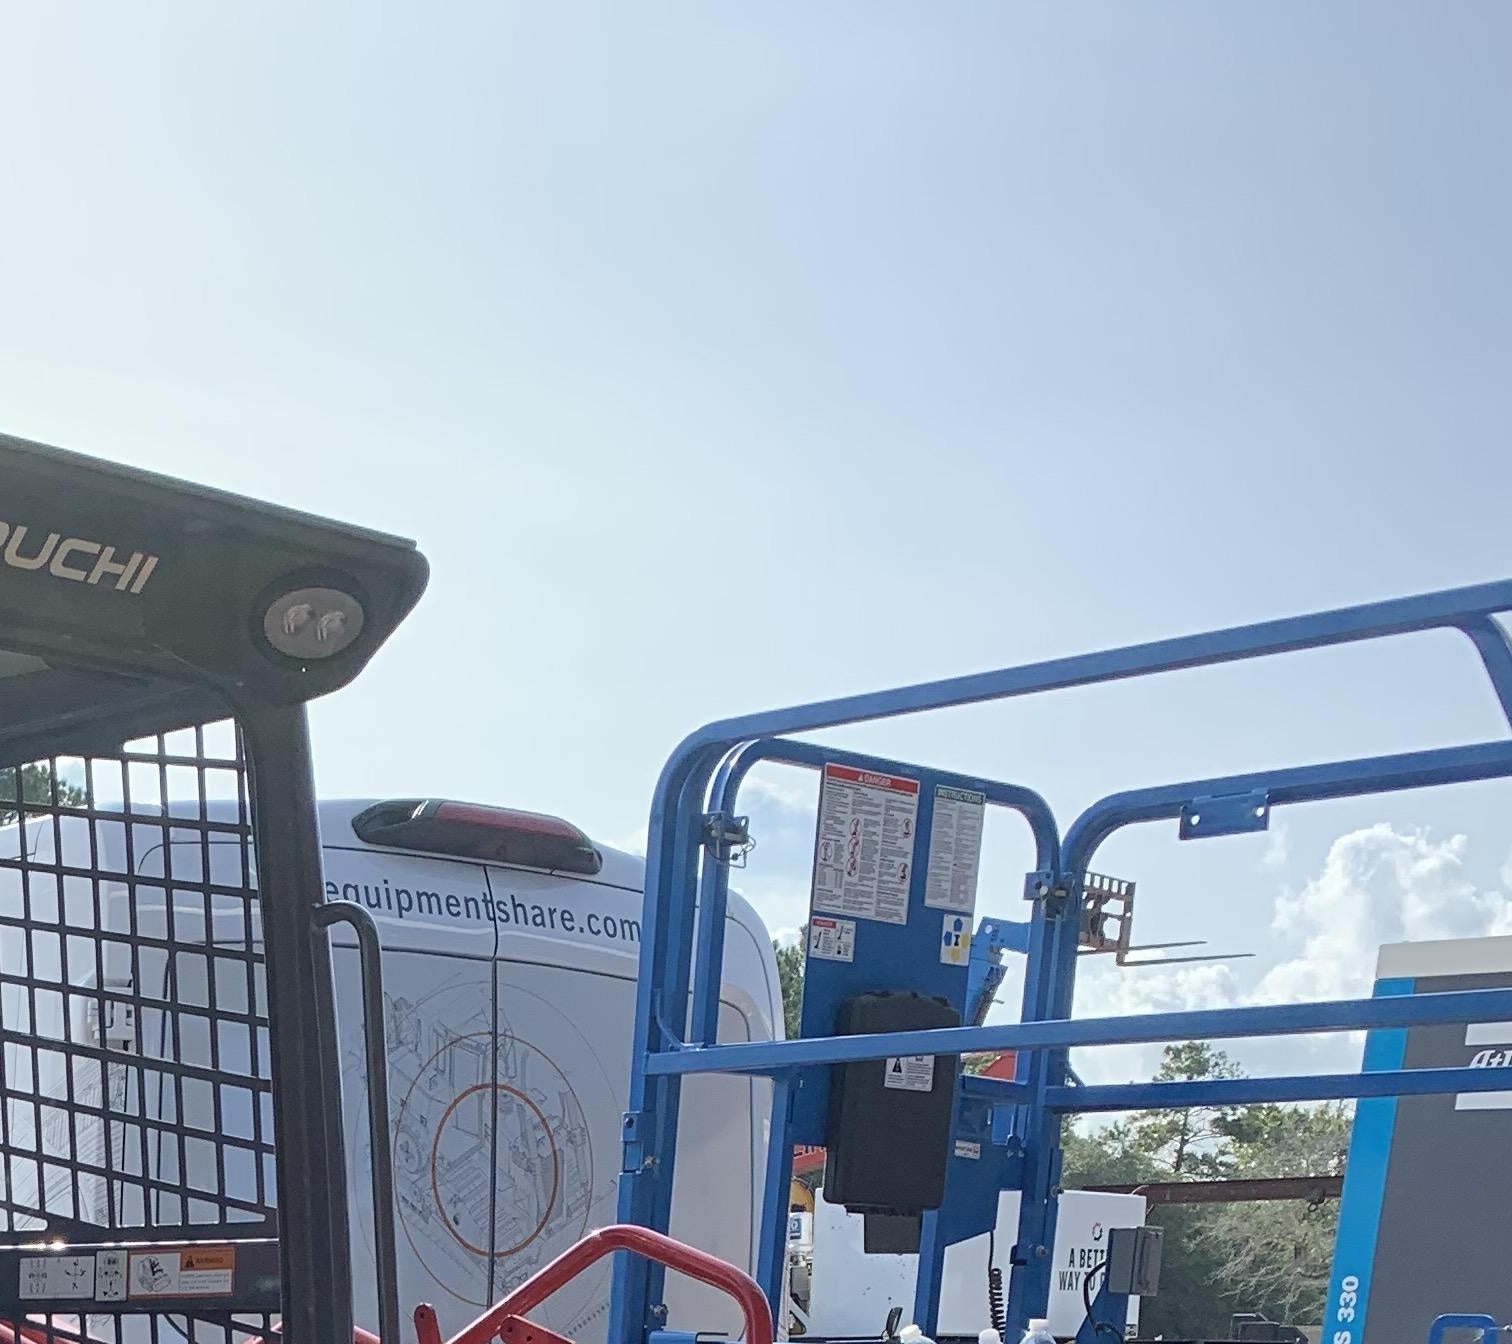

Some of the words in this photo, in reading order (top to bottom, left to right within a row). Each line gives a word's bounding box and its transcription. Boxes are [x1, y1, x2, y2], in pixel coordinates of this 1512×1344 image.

[1068, 1248, 1075, 1268] A
[1079, 1249, 1105, 1269] BETT
[1059, 1271, 1081, 1291] WAY
[1337, 1275, 1359, 1323] 330
